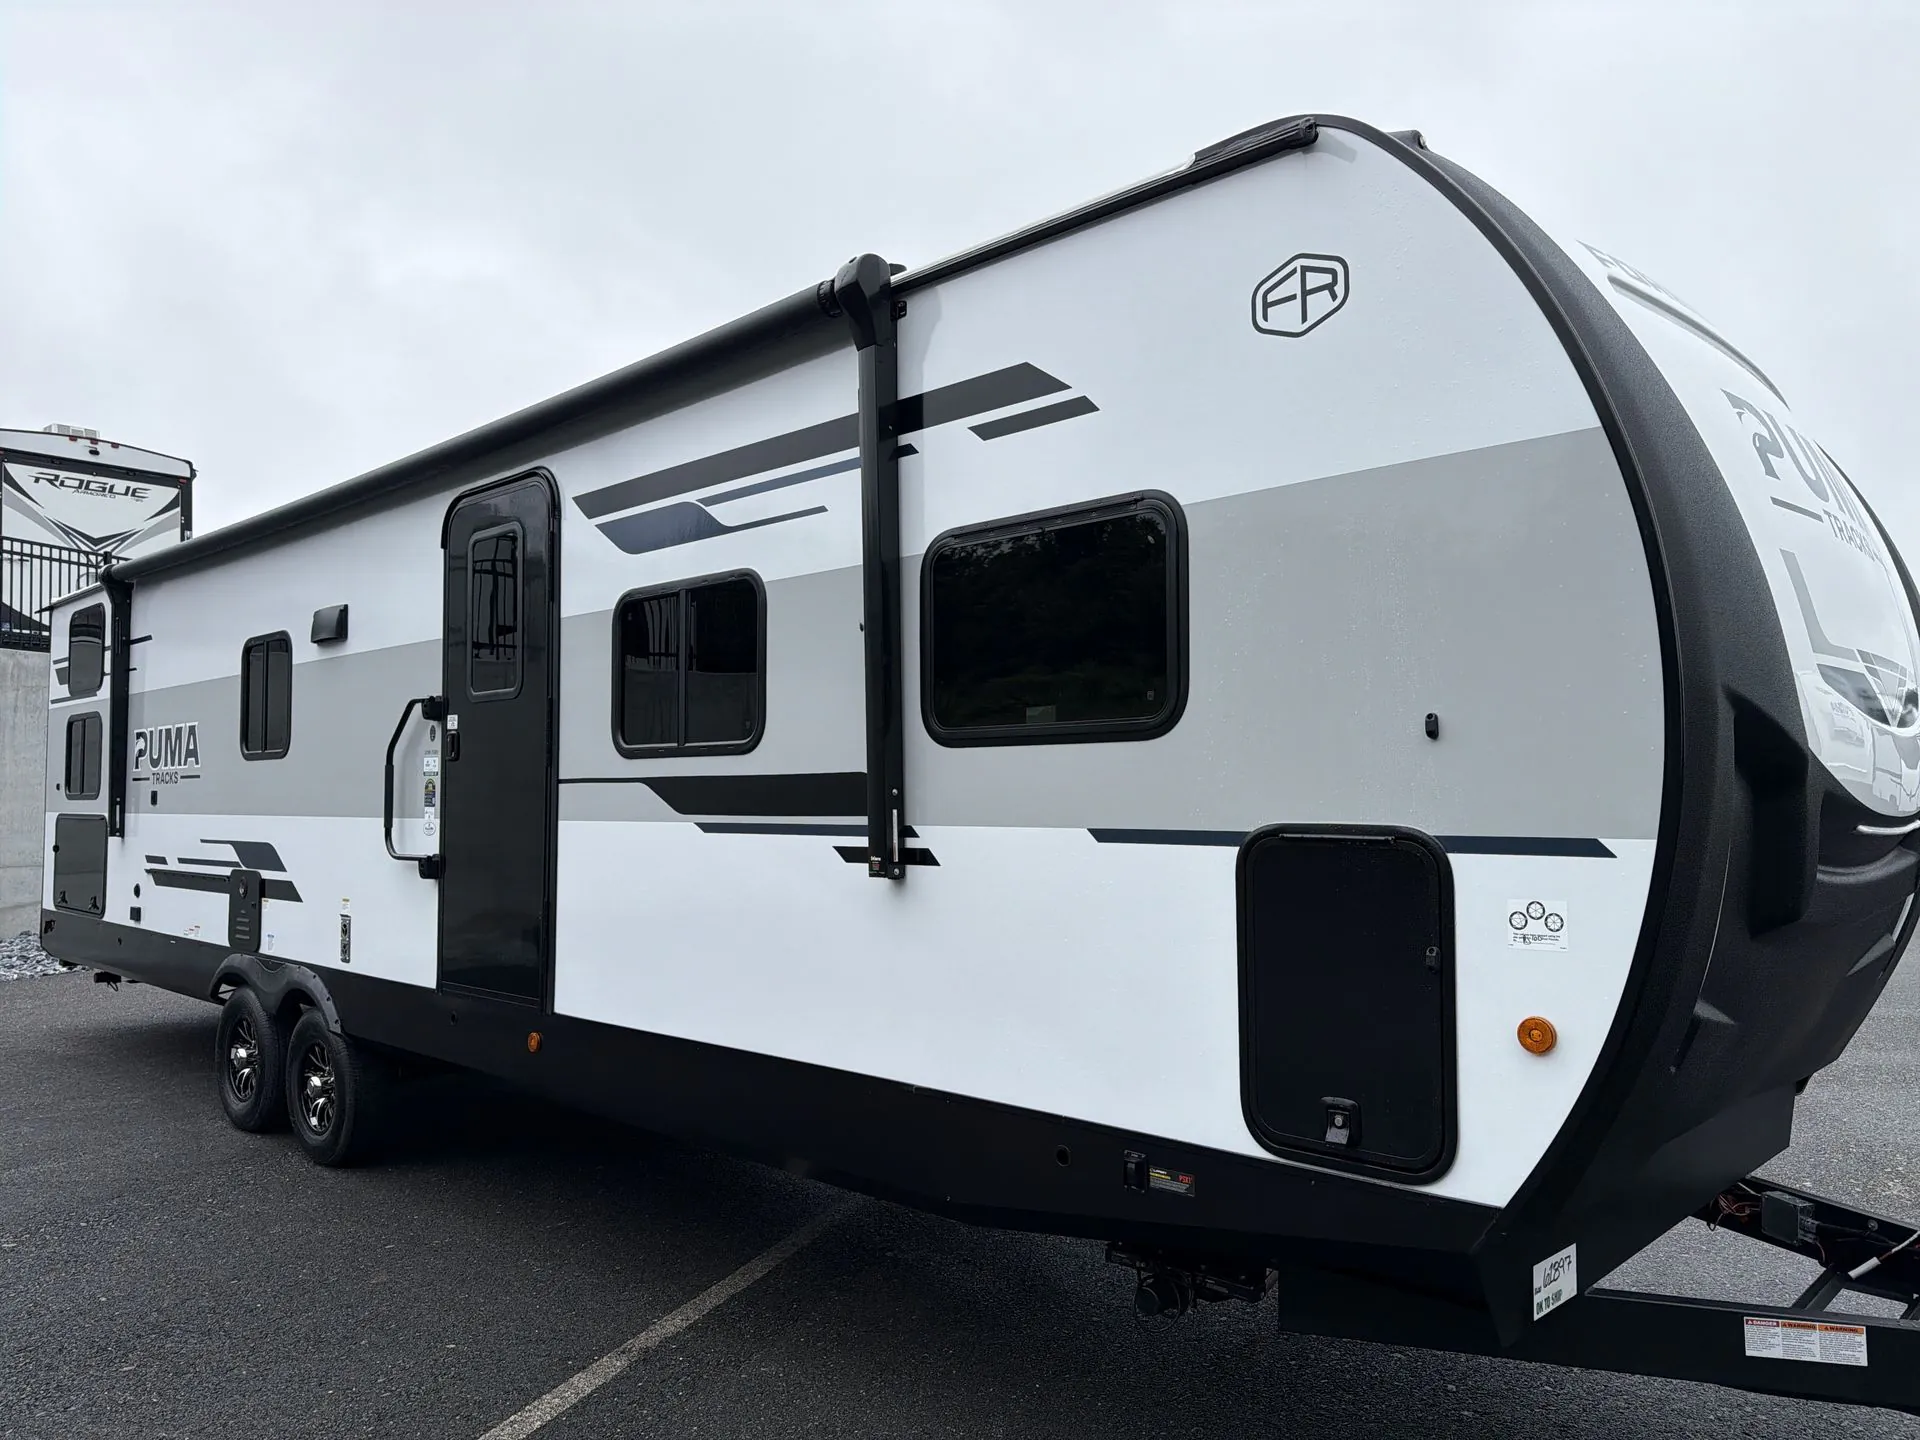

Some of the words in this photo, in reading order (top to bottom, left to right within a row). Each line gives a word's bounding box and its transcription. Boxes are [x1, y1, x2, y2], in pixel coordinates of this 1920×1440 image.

[27, 471, 152, 499] ROGUE
[72, 488, 116, 499] ARMORED
[134, 723, 200, 770] PUMA
[151, 772, 179, 785] TRACKS
[1544, 1296, 1550, 1310] TO
